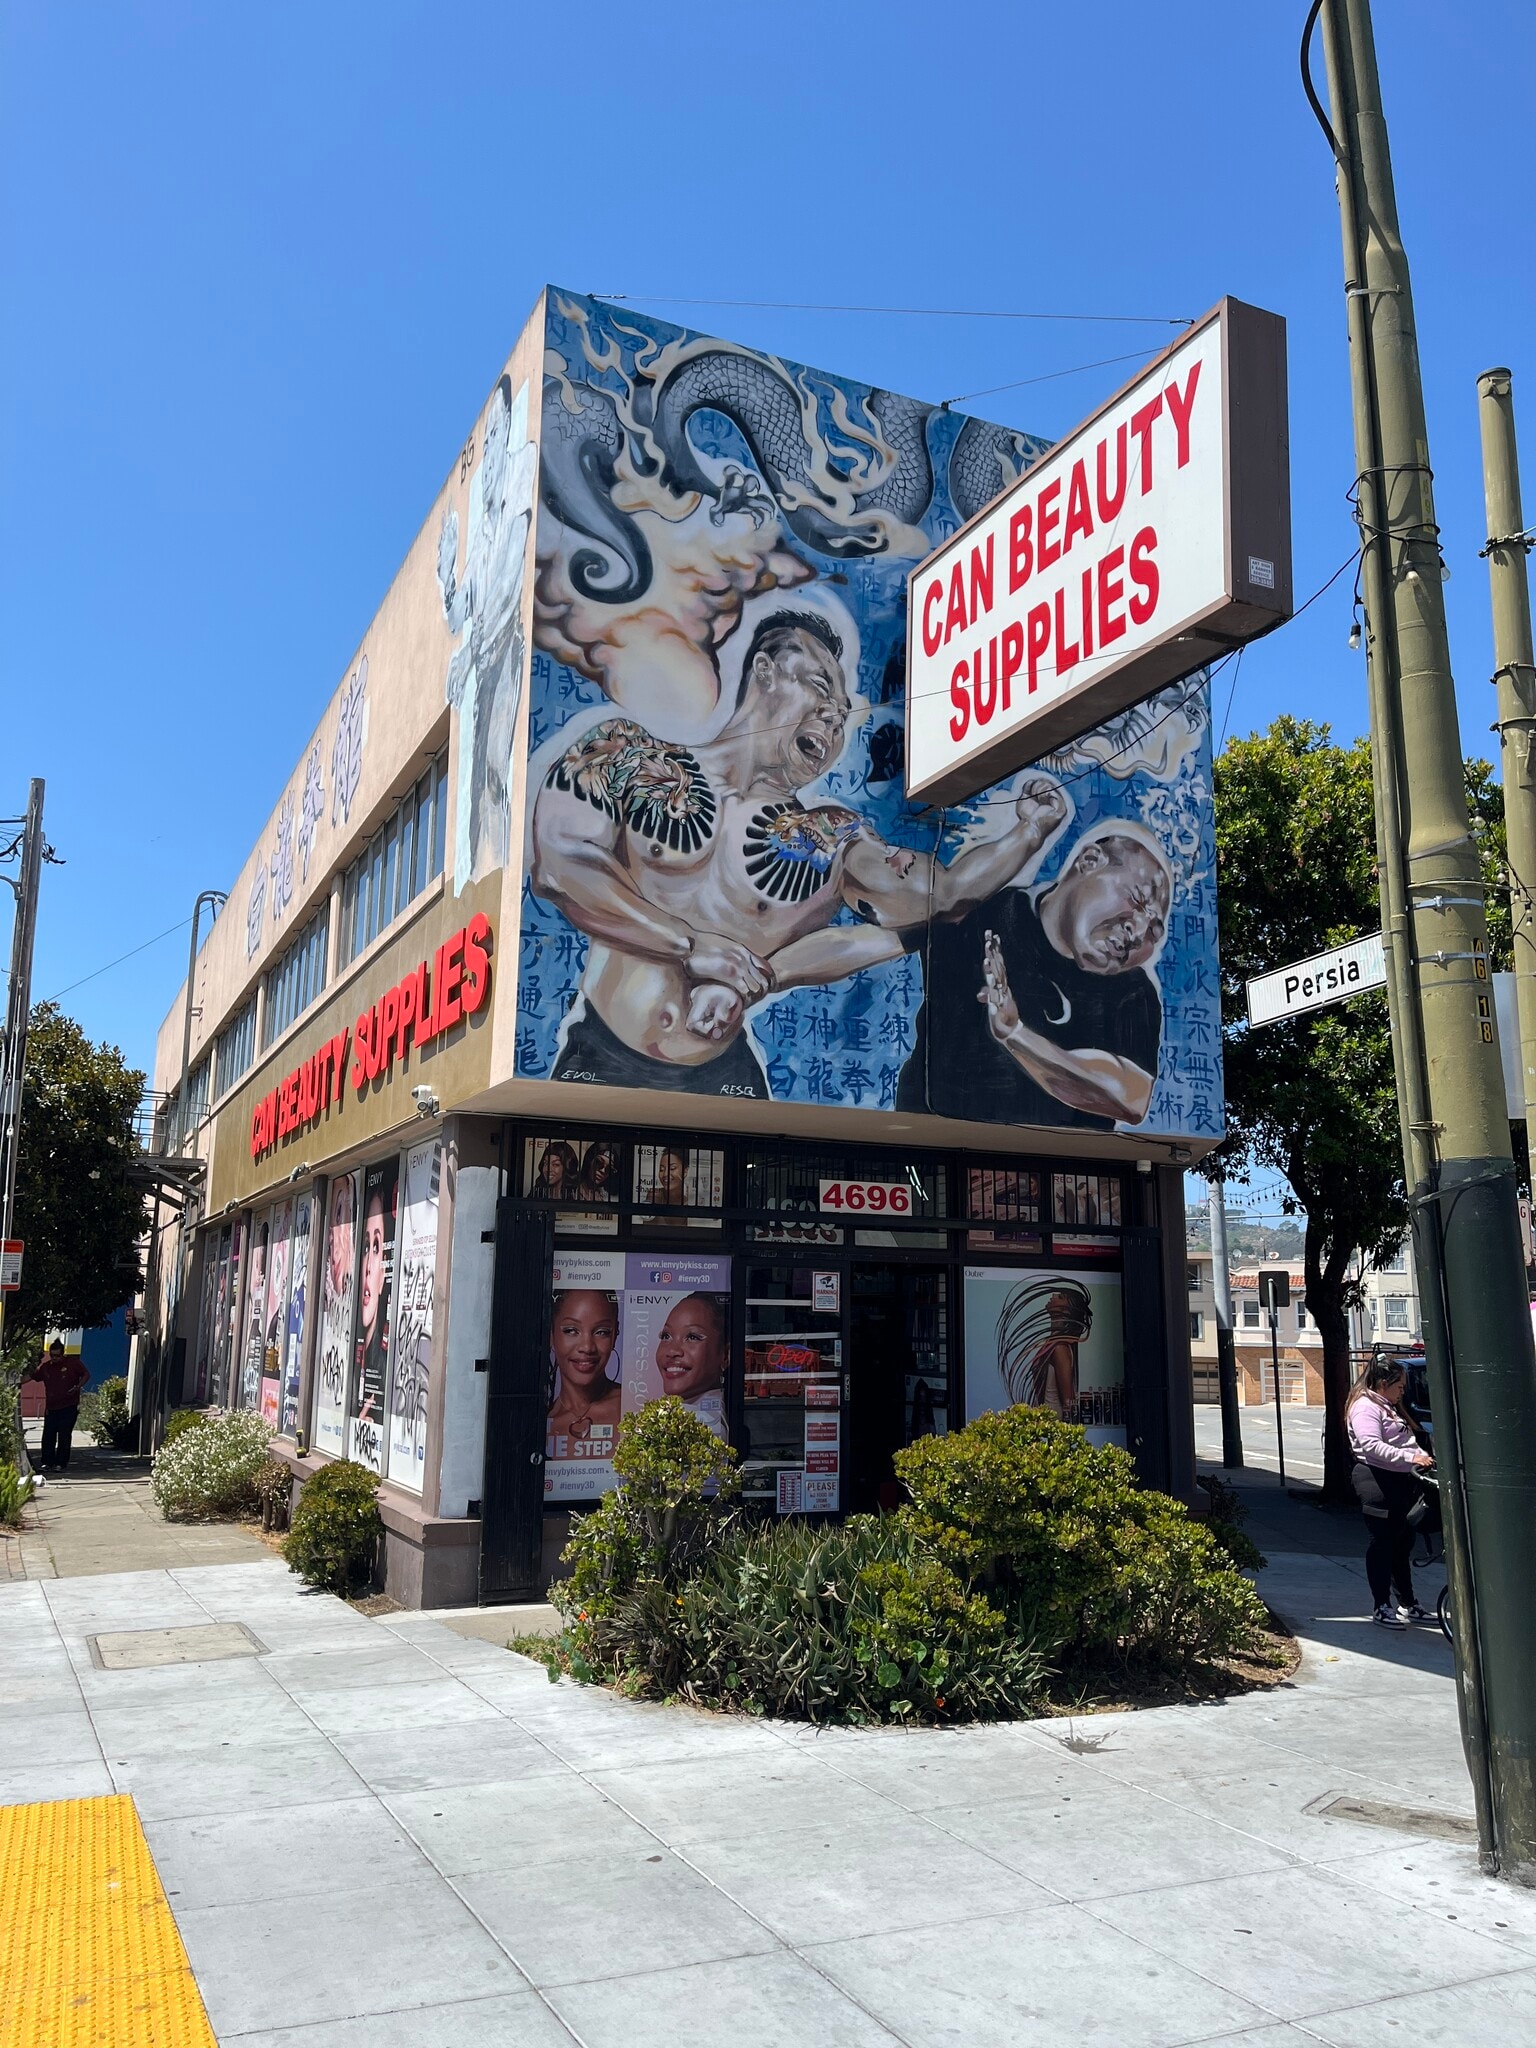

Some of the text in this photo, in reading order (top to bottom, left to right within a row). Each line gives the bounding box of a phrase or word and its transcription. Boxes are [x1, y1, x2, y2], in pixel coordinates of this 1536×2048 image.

[461, 436, 474, 486] BG
[923, 533, 994, 658] CAN
[1009, 359, 1202, 595] BEAUTY
[950, 526, 1160, 743] SUPPLIES
[1285, 957, 1361, 1004] Persia
[251, 1086, 279, 1158] CAN
[278, 1026, 349, 1139] BEAUTY
[351, 911, 490, 1090] SUPPLIES
[561, 1069, 607, 1083] EVOL
[719, 1084, 757, 1098] RESQ
[822, 1183, 909, 1212] 4696
[640, 1259, 719, 1271] www.ienvybykiss.com
[567, 1272, 602, 1282] #ienvy3D
[678, 1274, 710, 1284] #ienvy3D
[767, 1346, 814, 1366] Open
[574, 1441, 613, 1456] STEP
[560, 1481, 595, 1491] #ienvy3D
[807, 1482, 836, 1491] PLEASE
